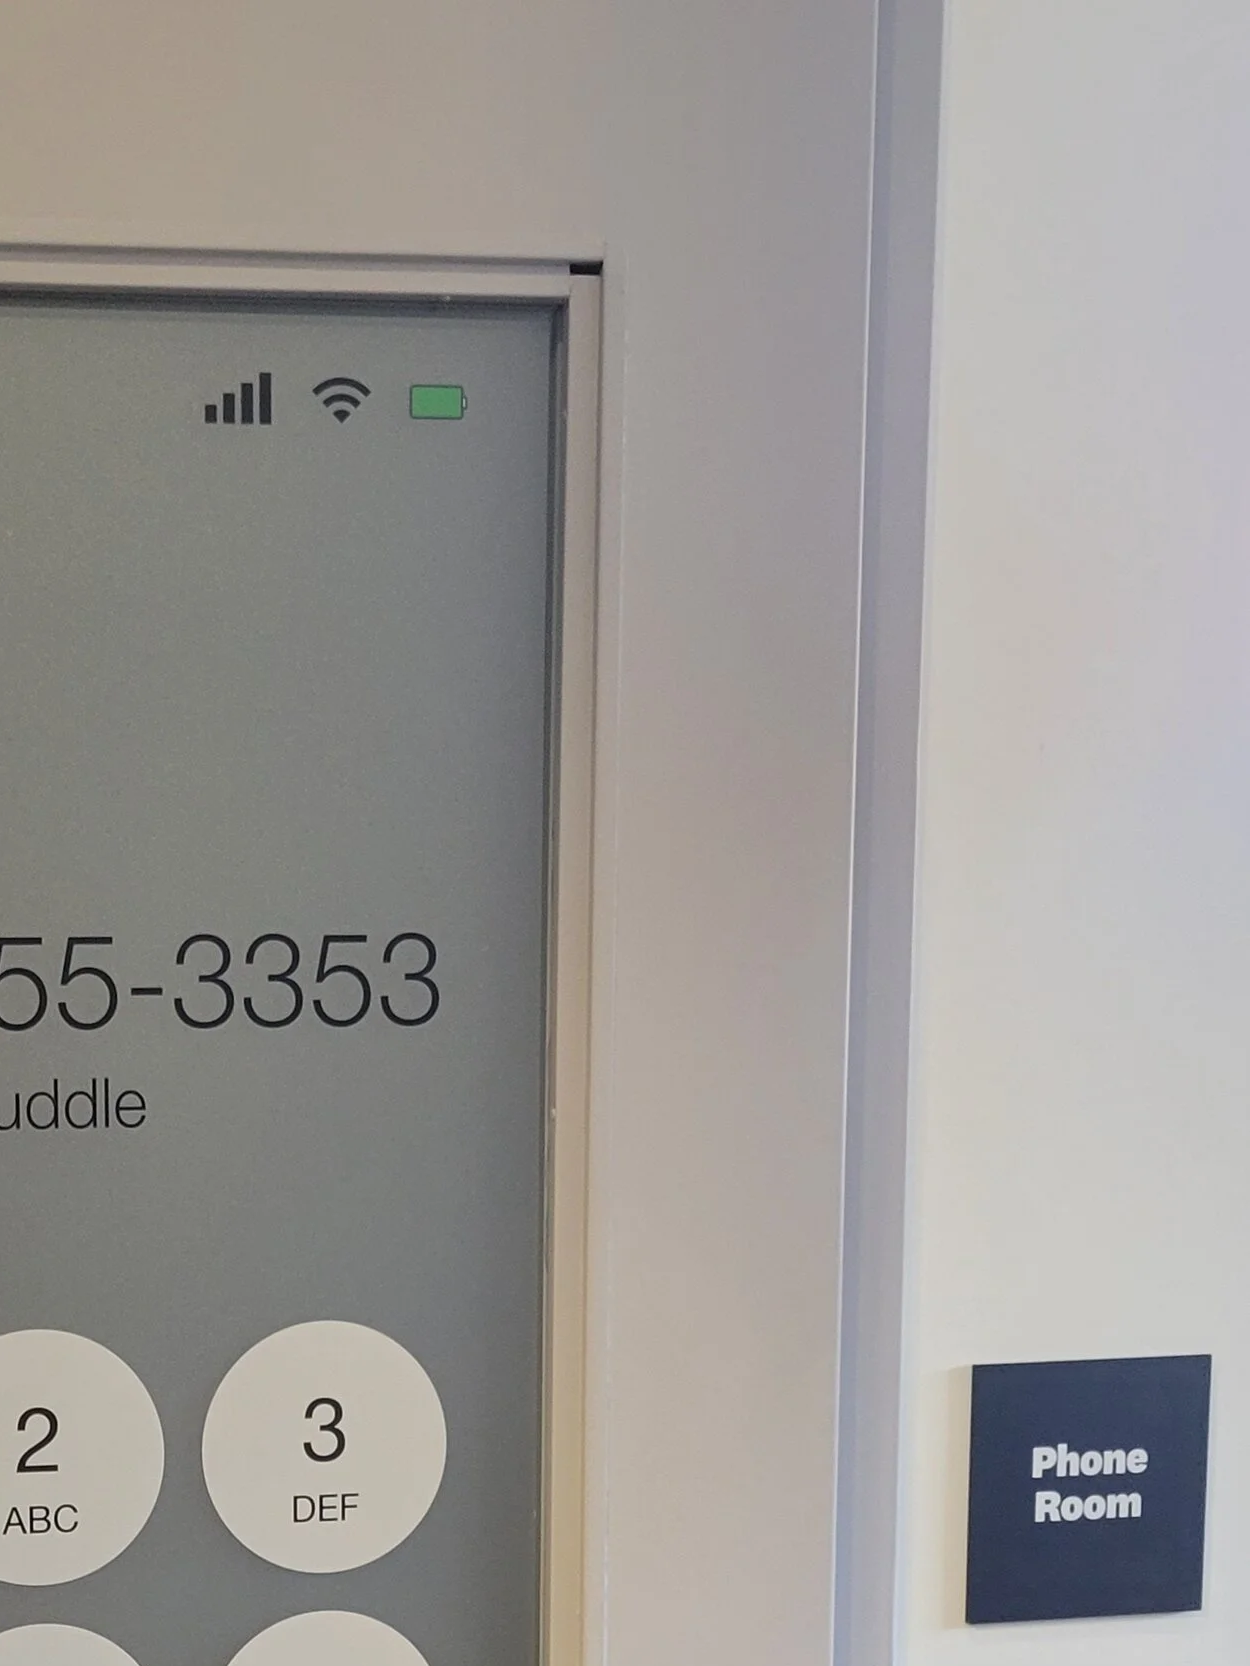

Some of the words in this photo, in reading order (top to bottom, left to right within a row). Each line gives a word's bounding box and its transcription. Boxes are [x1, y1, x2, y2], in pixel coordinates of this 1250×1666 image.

[16, 1407, 59, 1473] 2
[303, 1397, 346, 1463] 3
[1031, 1442, 1149, 1479] Phone
[2, 1504, 79, 1535] ABC
[293, 1492, 359, 1523] DEF
[1034, 1490, 1142, 1523] Room
